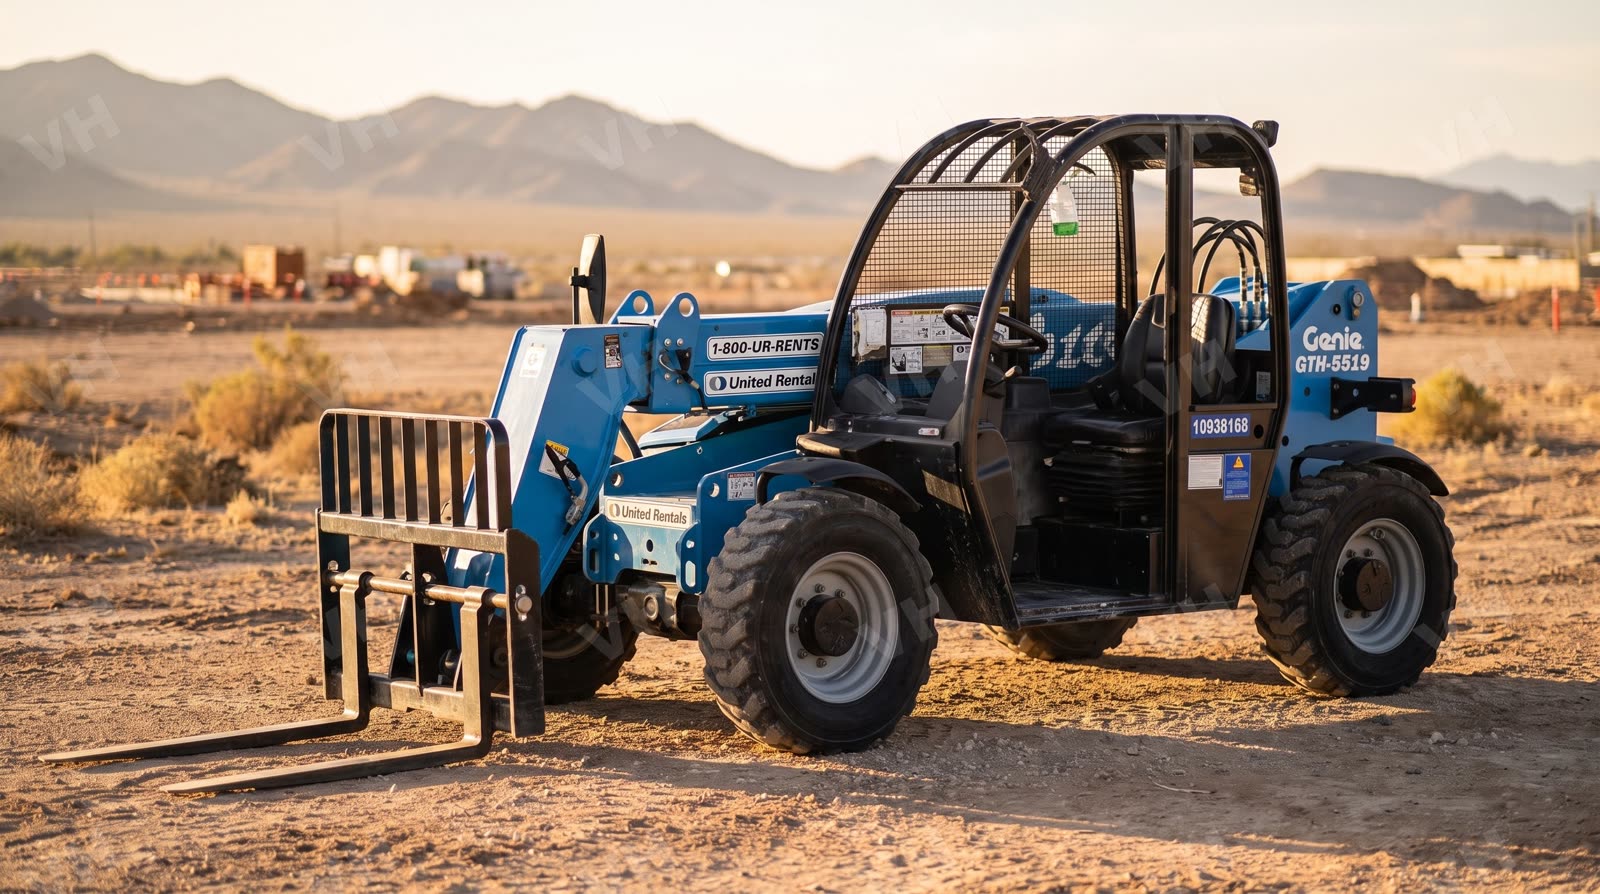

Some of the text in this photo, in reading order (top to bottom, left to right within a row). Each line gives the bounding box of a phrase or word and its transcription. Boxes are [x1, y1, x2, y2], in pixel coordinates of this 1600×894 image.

[711, 338, 820, 355] 1-800-UR-RENTS
[1303, 325, 1364, 352] Genie
[1295, 353, 1370, 374] GTH-5519
[729, 372, 817, 389] United Rental
[1193, 417, 1249, 435] 10938168
[621, 503, 688, 525] United Rentals
